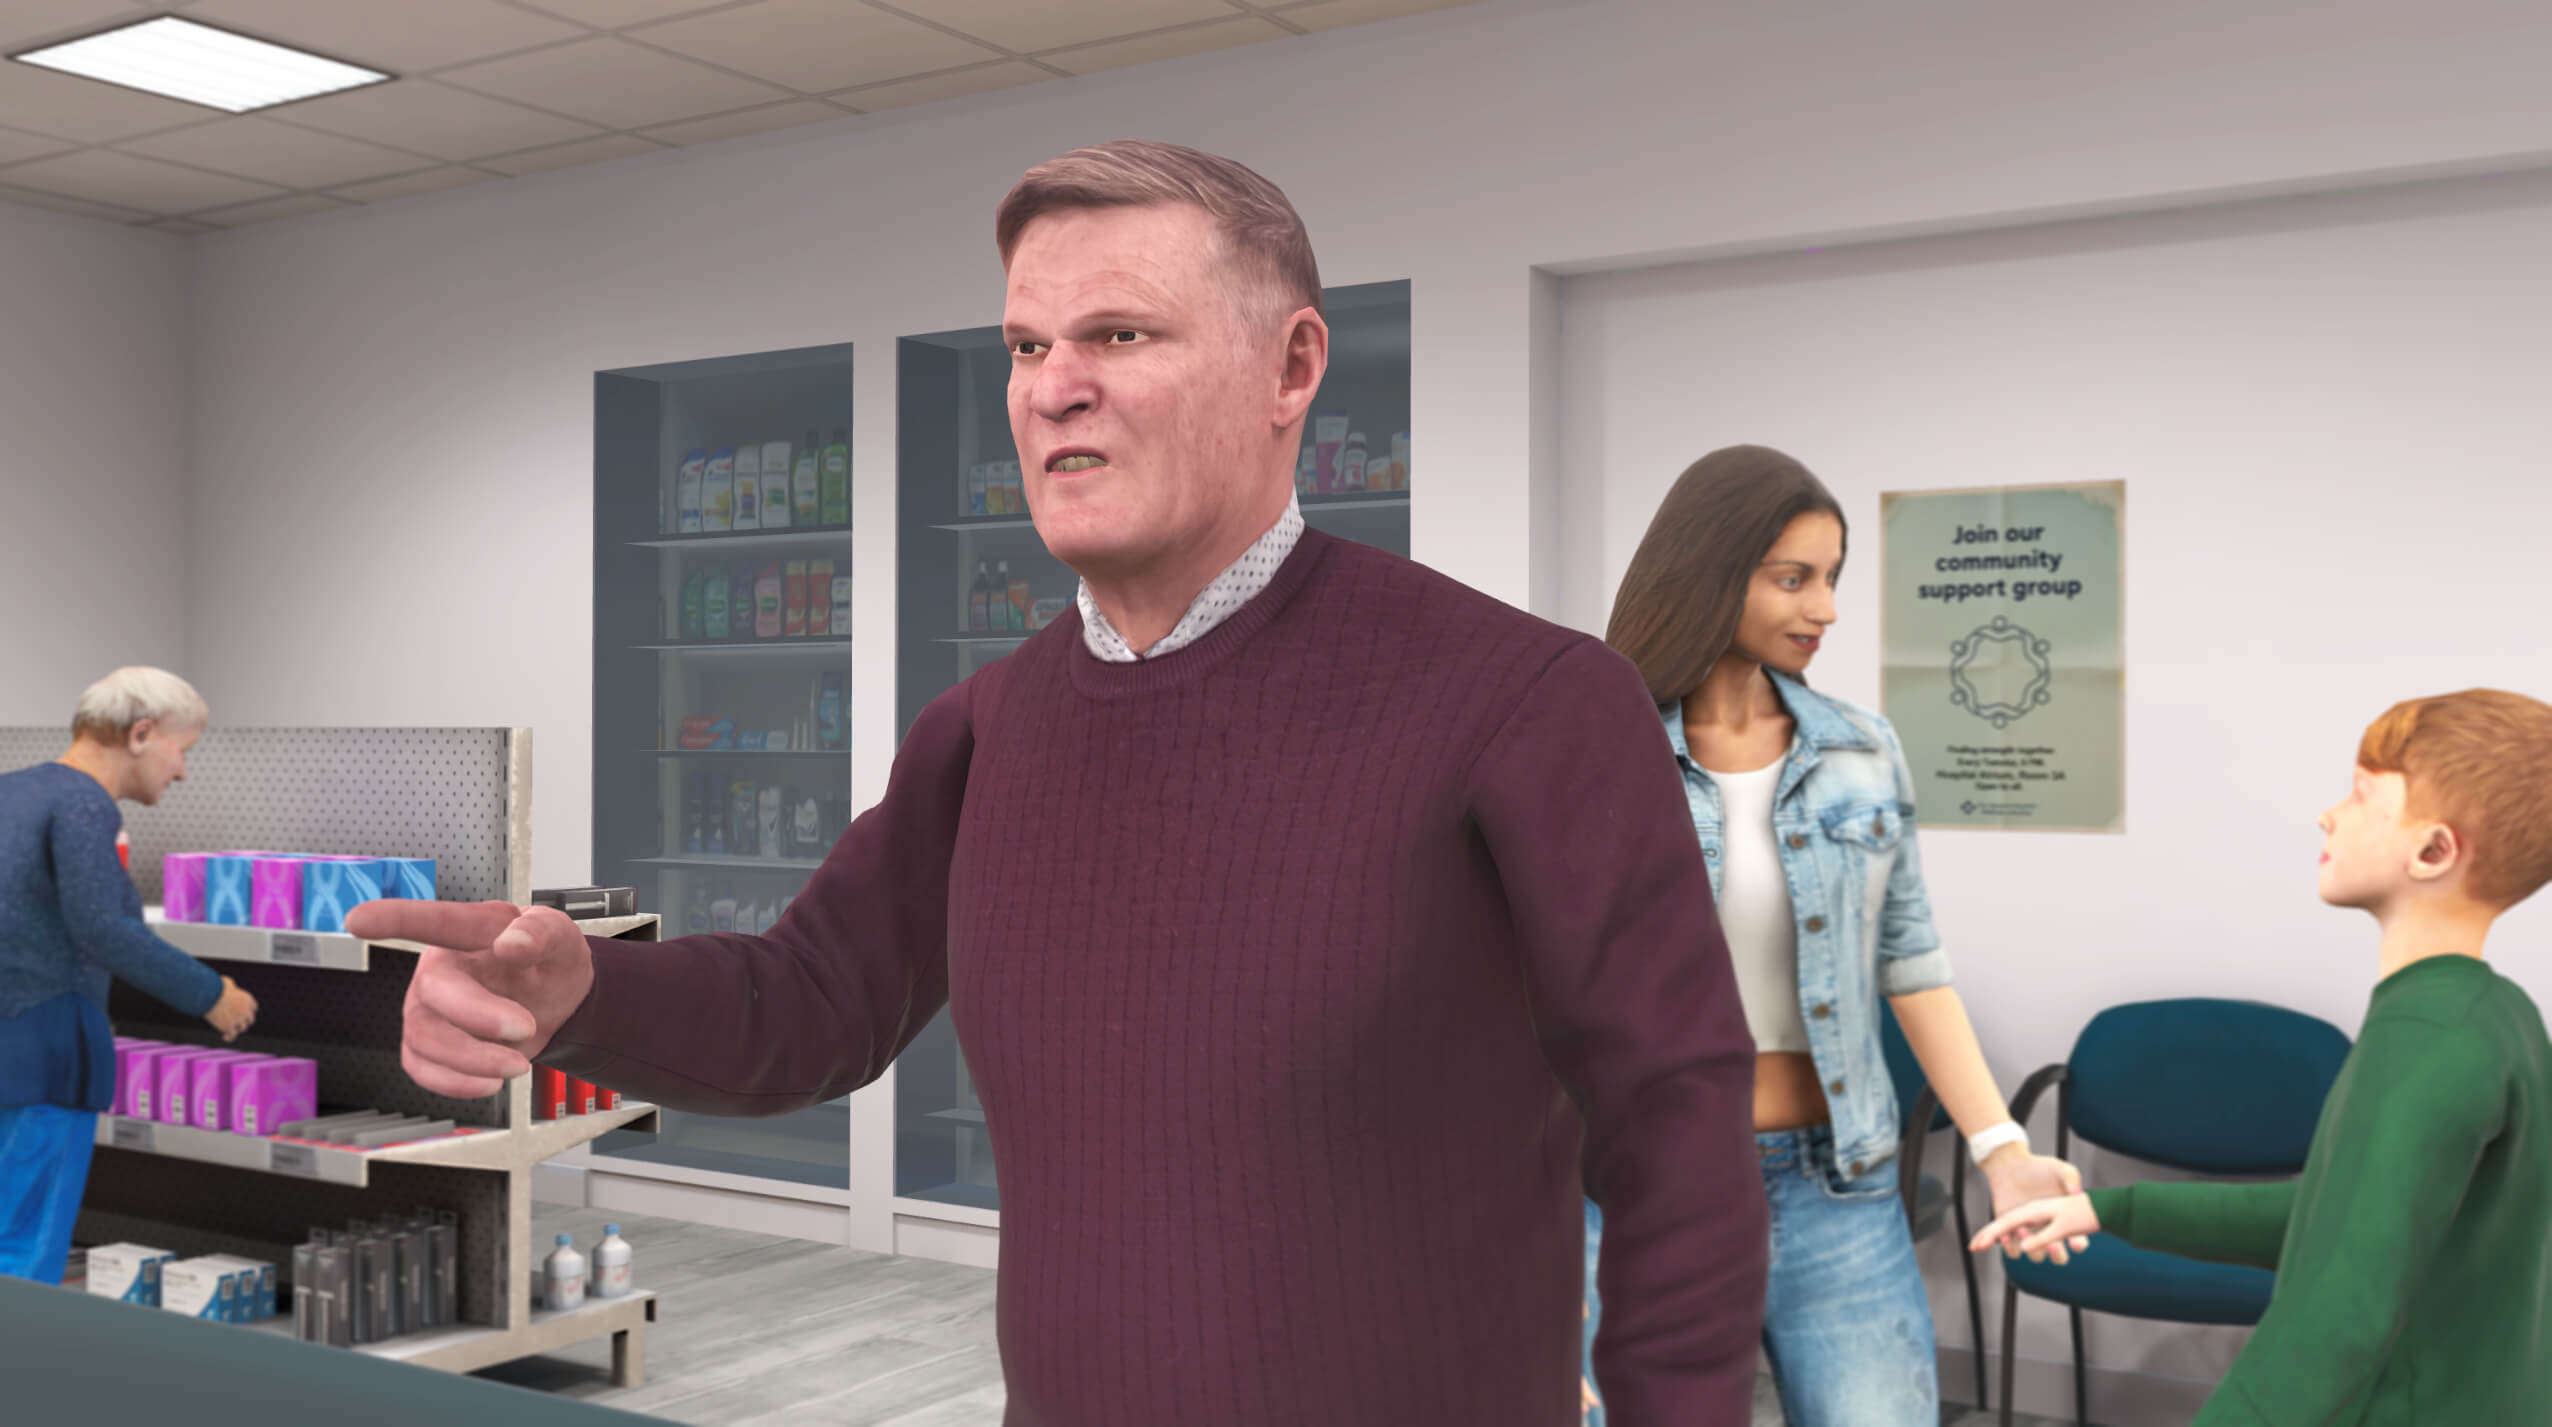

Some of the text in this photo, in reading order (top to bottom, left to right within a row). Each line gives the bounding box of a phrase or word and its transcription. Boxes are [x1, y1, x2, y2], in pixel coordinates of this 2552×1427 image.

[1953, 523, 2045, 544] Join our
[1935, 549, 2062, 573] community
[1918, 580, 2082, 603] support group
